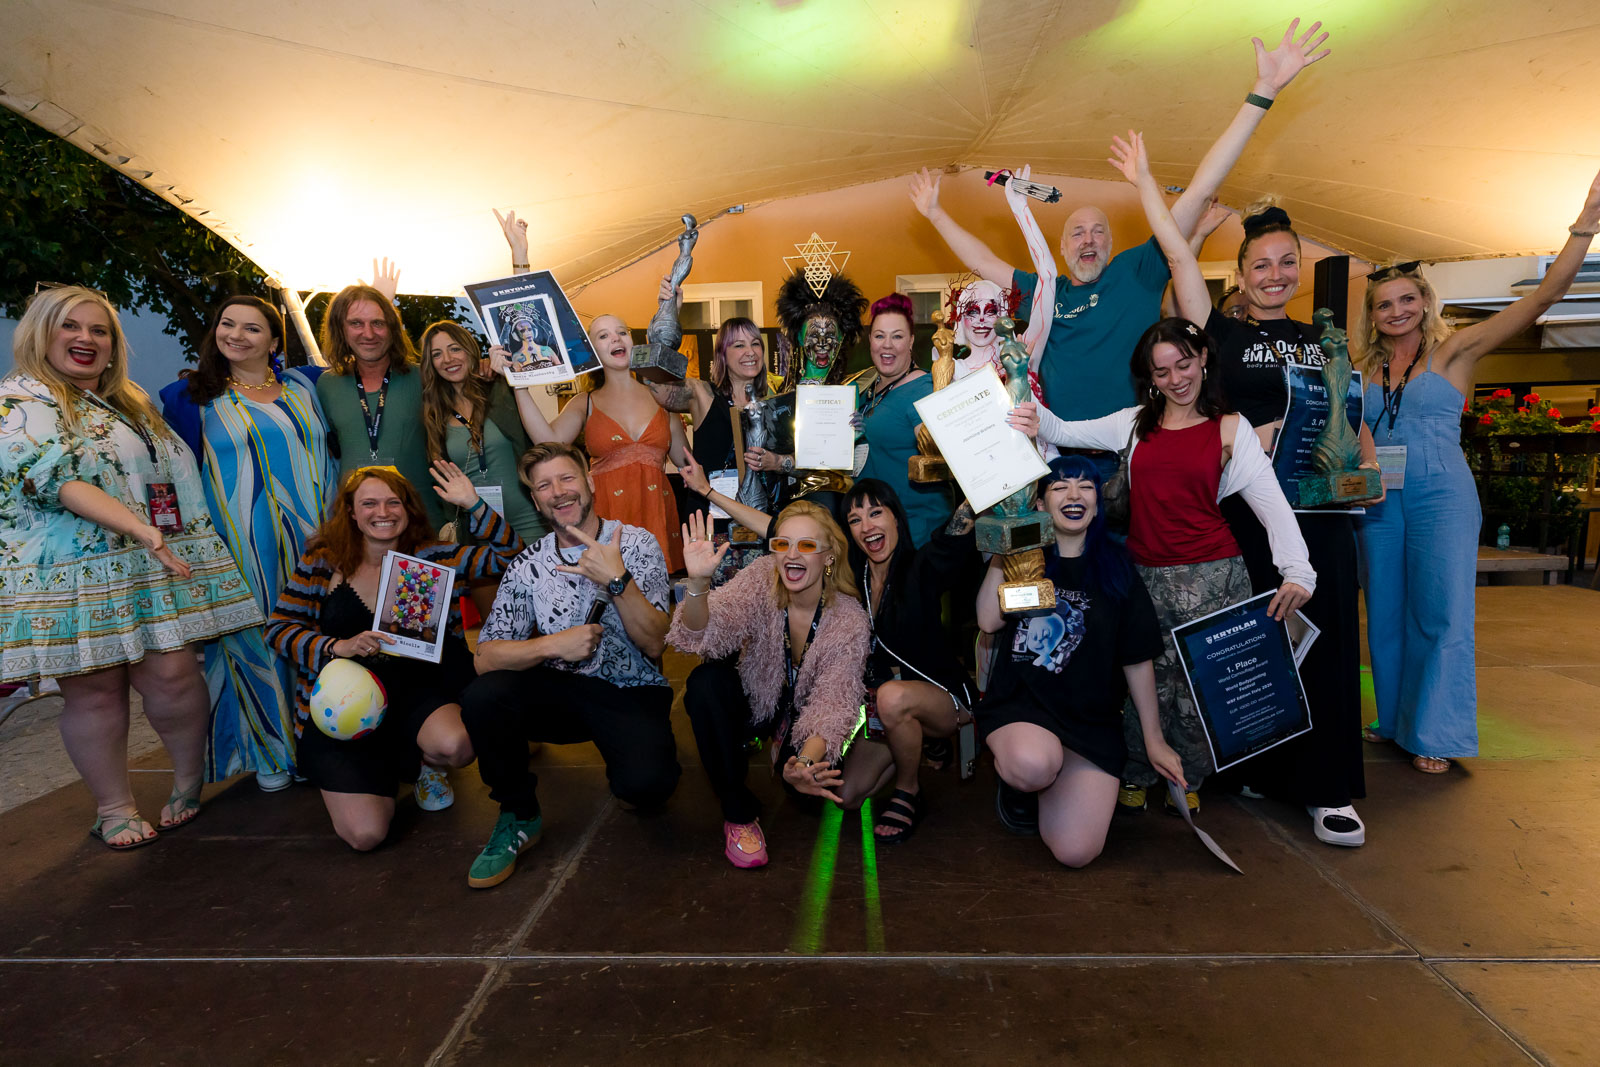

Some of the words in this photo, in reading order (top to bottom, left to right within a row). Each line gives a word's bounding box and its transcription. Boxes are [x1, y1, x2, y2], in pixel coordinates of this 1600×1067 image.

[937, 389, 991, 421] CERTIFICATE
[1212, 618, 1257, 640] KRYOLAN
[1206, 633, 1267, 660] CONGRATULATIONS
[1226, 665, 1235, 674] 1.
[1235, 657, 1257, 671] Place
